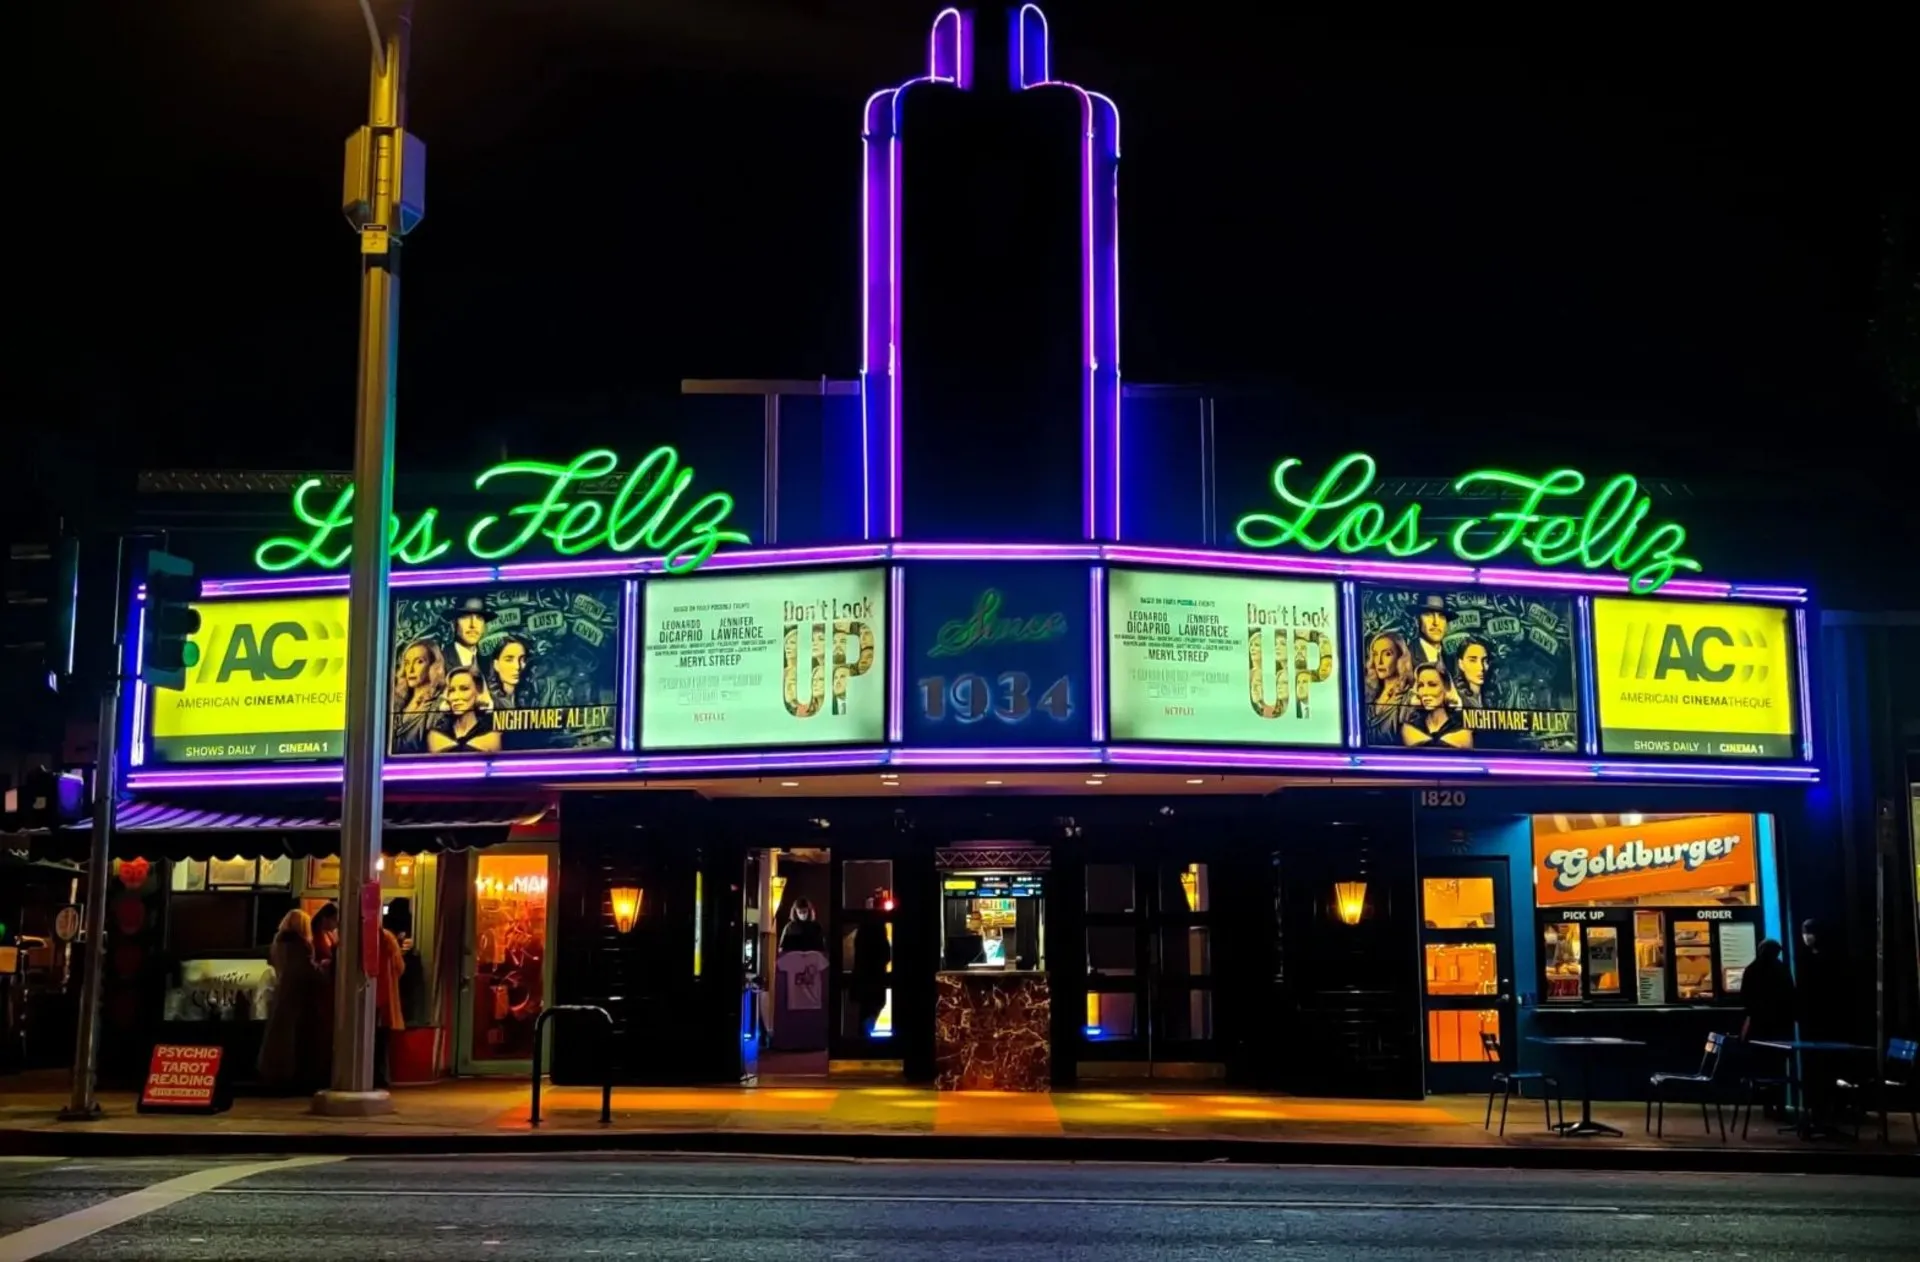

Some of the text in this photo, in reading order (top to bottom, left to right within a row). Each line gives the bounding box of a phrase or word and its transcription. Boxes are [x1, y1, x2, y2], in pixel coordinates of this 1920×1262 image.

[255, 446, 752, 575] Ls Feliz
[1236, 453, 1703, 595] Los Feliz
[784, 596, 874, 622] Don't Look
[1129, 610, 1168, 623] LEONARDO
[1247, 603, 1331, 628] Don't Look
[533, 614, 558, 629] LUST
[662, 619, 701, 631] LEONARDO
[719, 616, 754, 628] JENNIFER
[926, 587, 1068, 659] Since
[1187, 613, 1220, 625] JENNIFER
[711, 626, 764, 641] LAWRENCE
[1178, 623, 1230, 638] LAWRENCE
[1492, 620, 1516, 635] LUST
[215, 621, 309, 684] AC
[1148, 649, 1209, 663] MERYL STREEP
[1653, 624, 1737, 683] AC
[680, 654, 742, 668] MERYL STREEP
[783, 621, 874, 718] UP
[1248, 627, 1333, 719] UP
[176, 691, 344, 710] AMERICAN CINEMATHEQUE
[917, 670, 1075, 724] 1934
[1620, 692, 1773, 709] AMERICAN CINEMATHEQUE
[493, 706, 609, 731] NIGHTMARE ALLEY
[1463, 709, 1570, 731] NIGHTMARE ALLEY
[185, 742, 329, 757] SHOWS DAILY CINEMA 1
[1634, 740, 1764, 755] SHOWS DAILY CINEMA 1
[1421, 790, 1466, 806] 1820
[1547, 835, 1741, 889] Goldburger
[1563, 911, 1605, 921] PICK UP
[1697, 910, 1732, 919] ORDER
[157, 1046, 219, 1059] PSYCHIC
[161, 1060, 210, 1073] TAROT
[150, 1073, 214, 1086] READING
